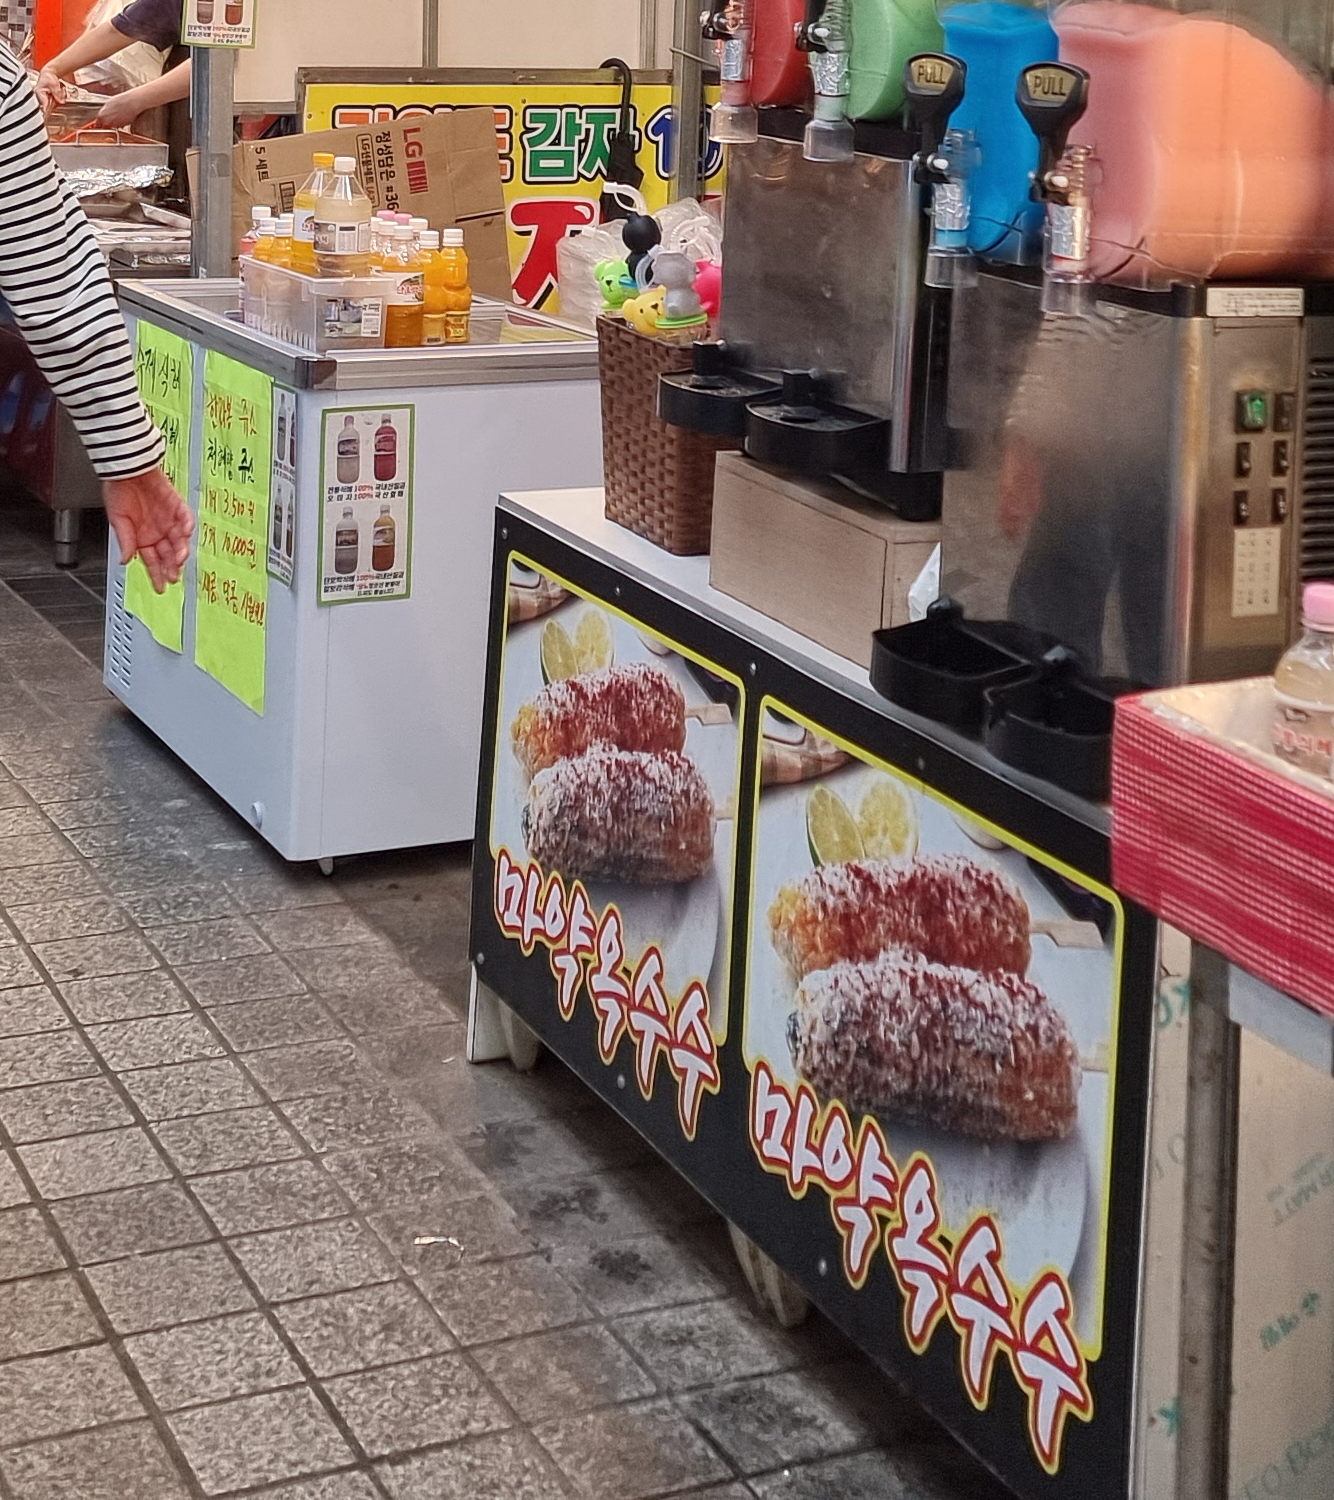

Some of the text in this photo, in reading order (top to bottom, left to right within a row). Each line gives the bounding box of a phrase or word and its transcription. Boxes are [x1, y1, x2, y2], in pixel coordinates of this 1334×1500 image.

[916, 66, 948, 87] PULL
[1031, 75, 1068, 98] PULL
[255, 146, 266, 155] 5
[375, 130, 396, 182] 정성담은
[402, 127, 424, 159] LG
[524, 104, 641, 183] 감자
[494, 849, 721, 1140] 마약옥수수
[749, 1060, 1094, 1465] 마약옥수수
